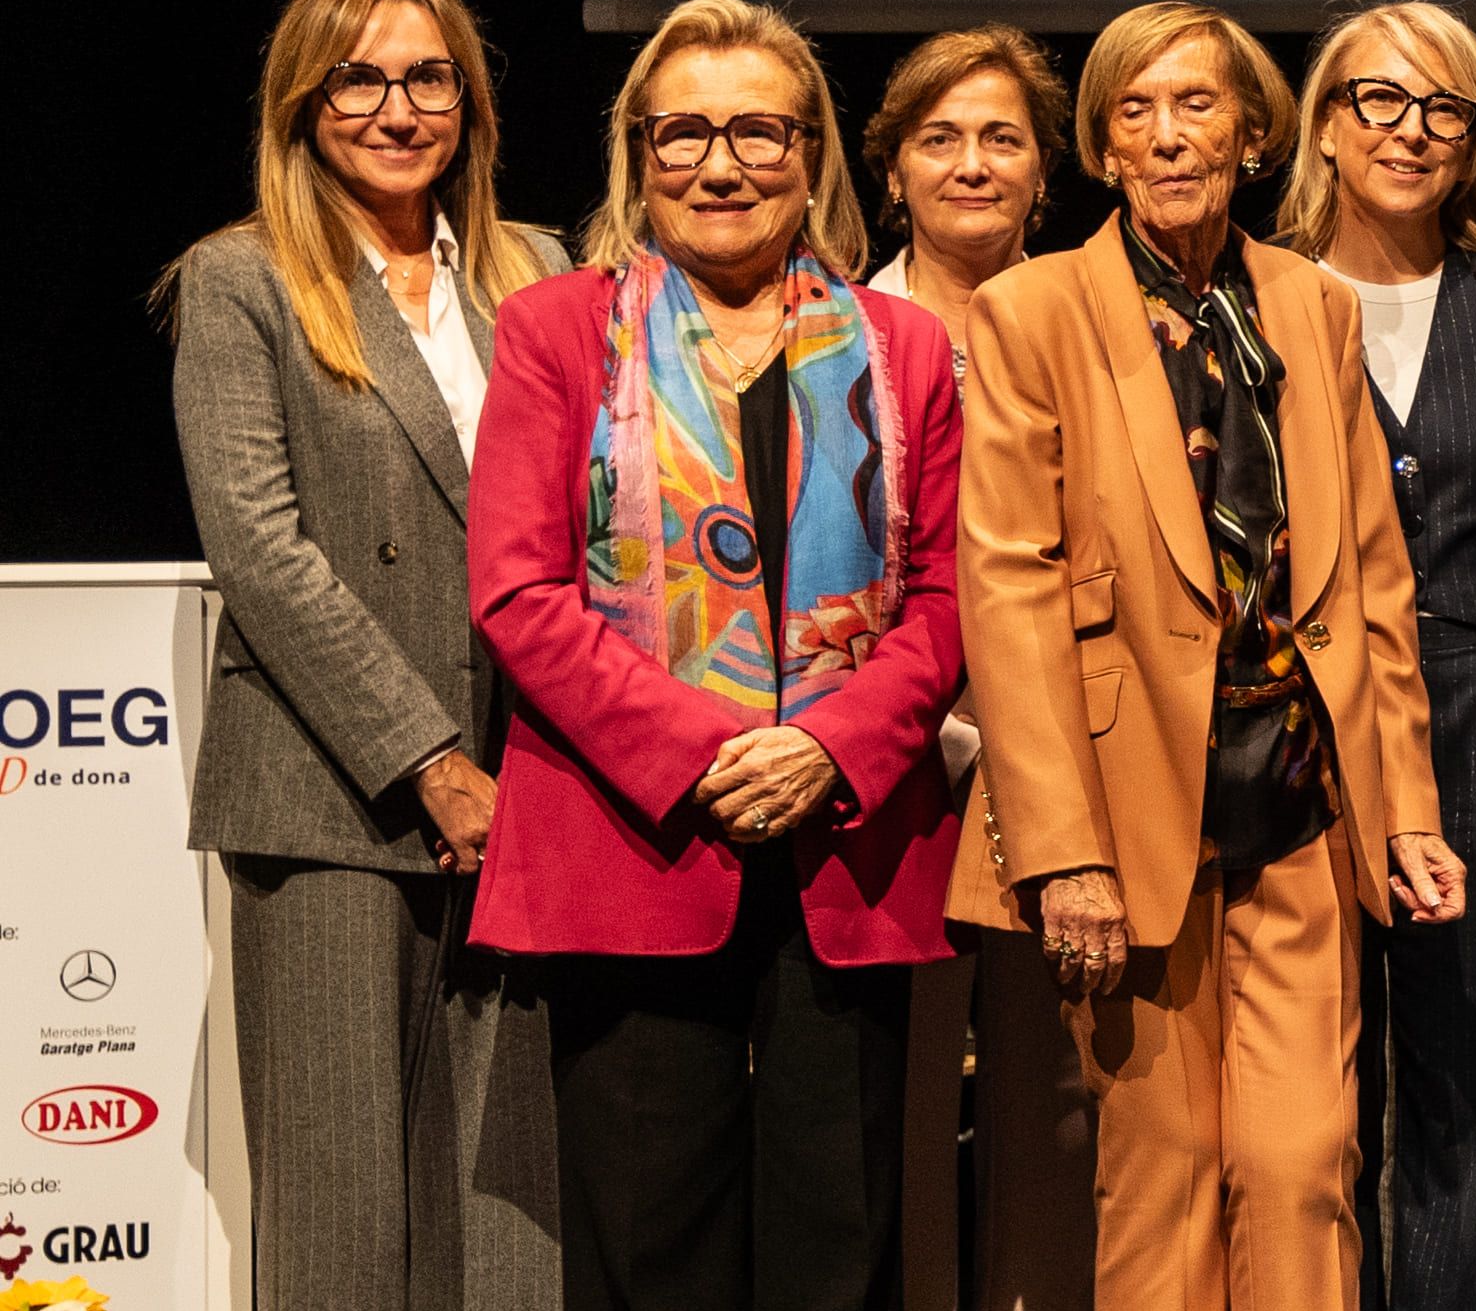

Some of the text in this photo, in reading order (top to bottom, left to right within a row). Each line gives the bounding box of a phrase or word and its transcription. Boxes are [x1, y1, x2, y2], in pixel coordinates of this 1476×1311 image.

[34, 769, 62, 786] de
[72, 768, 131, 785] dona
[0, 924, 19, 940] e:
[40, 1025, 137, 1040] Mercedes-Benz
[40, 1040, 136, 1057] Garatge Plana
[37, 1099, 127, 1132] DANI
[31, 1177, 61, 1194] de:
[43, 1222, 150, 1264] GRAU
